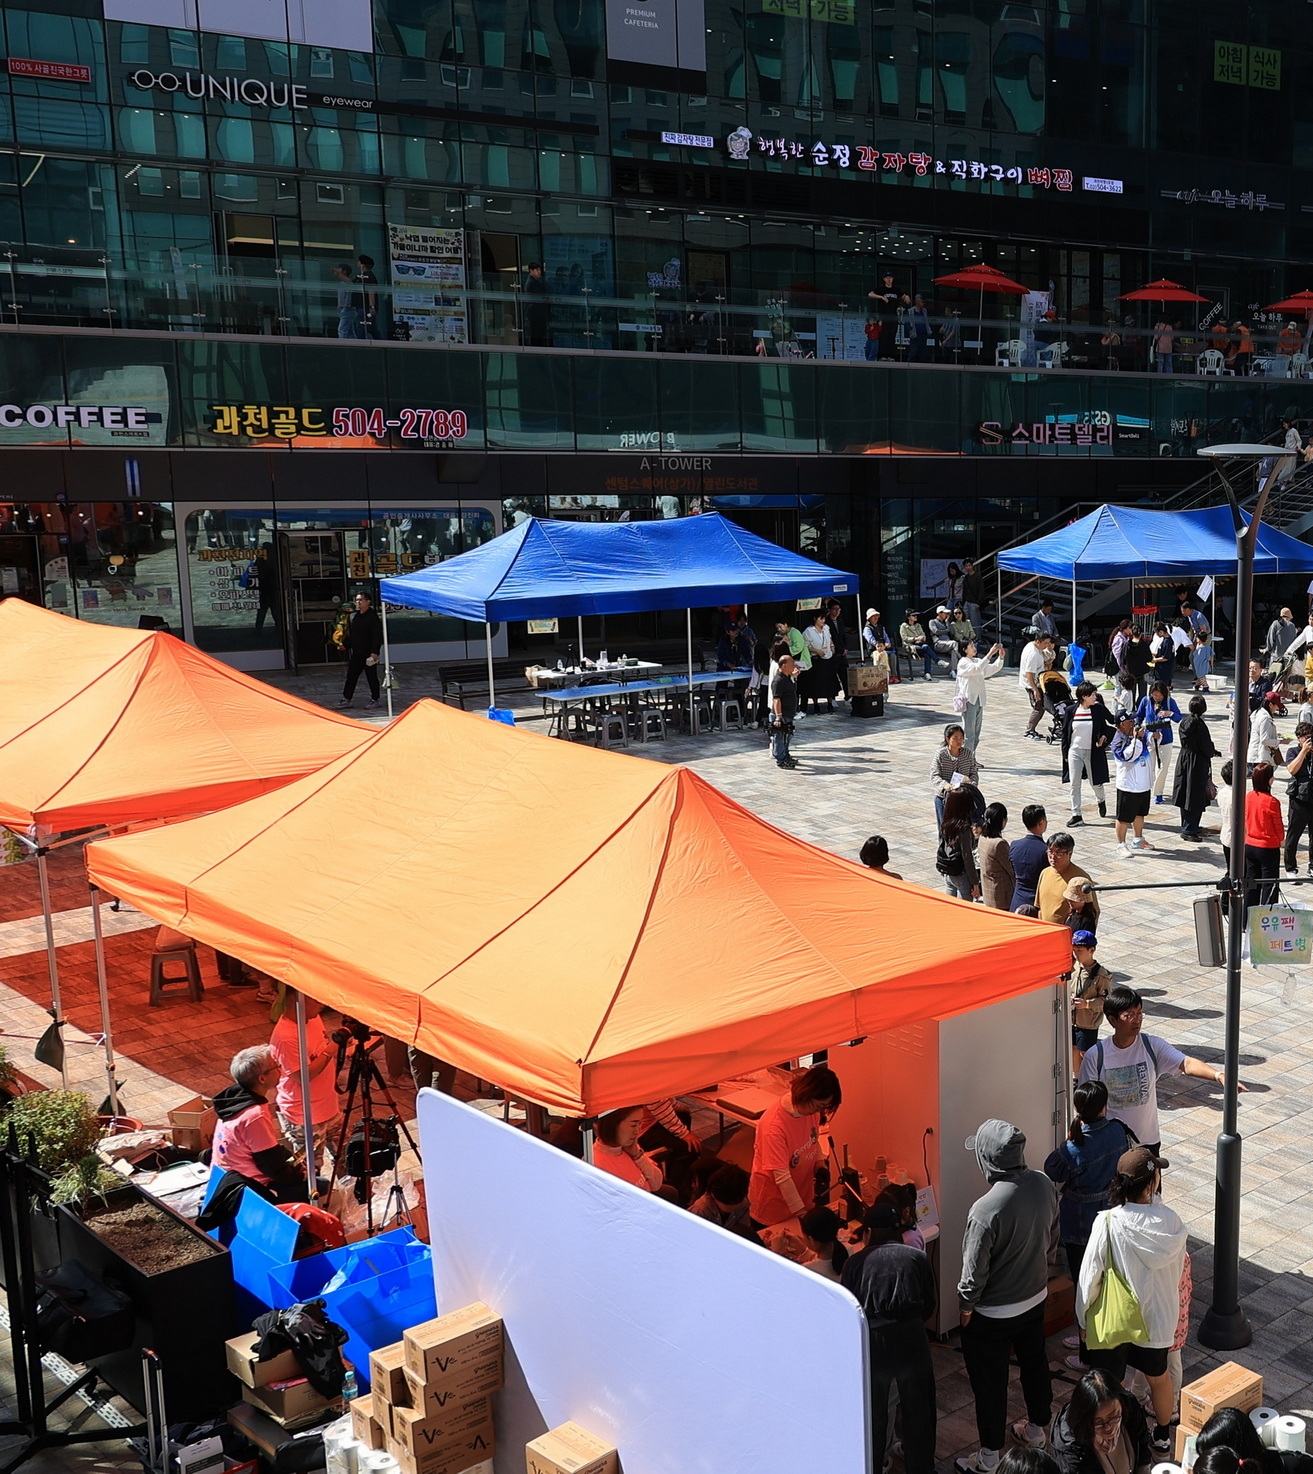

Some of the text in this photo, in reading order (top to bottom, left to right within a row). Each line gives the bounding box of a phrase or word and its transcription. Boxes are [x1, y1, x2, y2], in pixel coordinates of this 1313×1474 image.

[626, 8, 656, 19] PREMIUM
[624, 18, 659, 30] CAFETERIA
[1218, 45, 1278, 70] 아침 식사
[10, 60, 33, 73] 100%
[1218, 64, 1278, 87] 저녁 가능
[185, 72, 373, 110] UNIQUE eyewear
[757, 136, 1074, 192] 행복한 순정 감자탕 & 직화구이 뼈찜
[1207, 188, 1239, 209] 오늘
[1240, 190, 1270, 212] 하루
[420, 235, 450, 245] 떨어지는
[1251, 312, 1284, 323] 오늘 하루
[0, 404, 150, 430] COFFEE
[211, 404, 468, 440] 과천골드 504-2789
[1011, 422, 1113, 446] 스마트델리
[639, 457, 712, 471] A-TOWER
[703, 477, 760, 491] 열린도서관
[382, 512, 438, 520] 공인중개사사무소
[1261, 916, 1295, 931] 우유팩
[1269, 937, 1307, 953] 페트병
[1135, 1063, 1149, 1103] REVIVA
